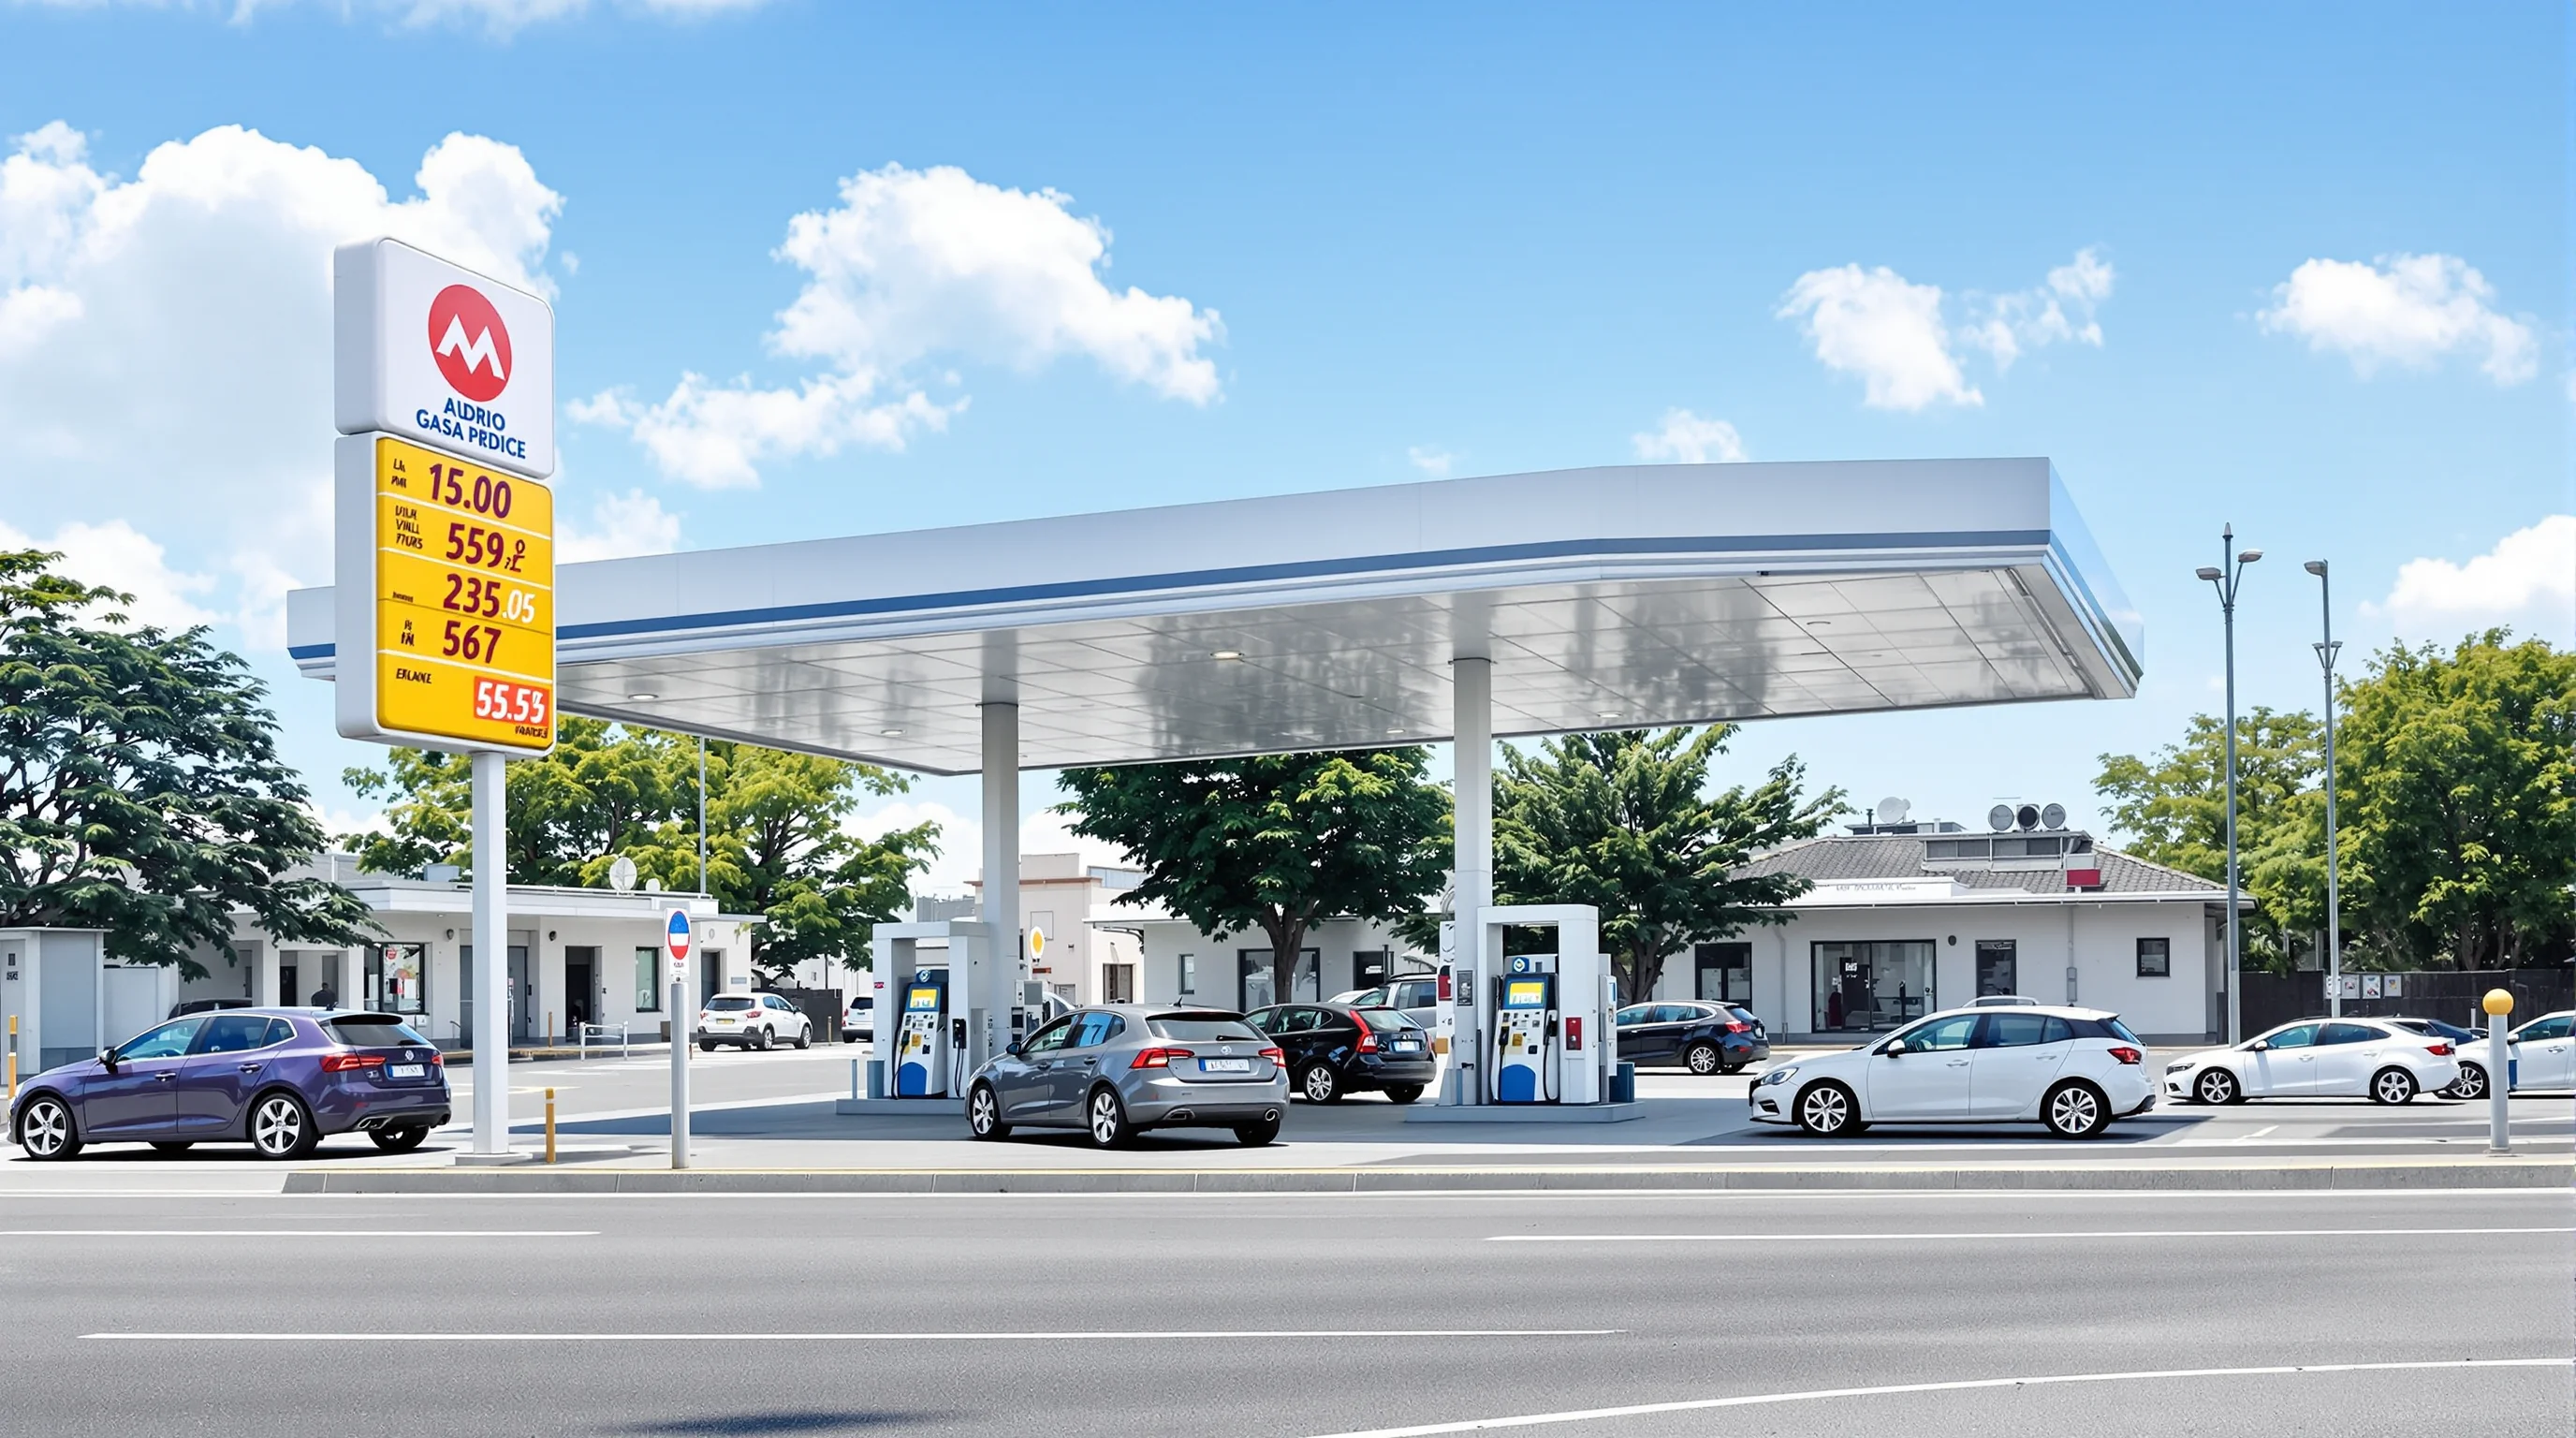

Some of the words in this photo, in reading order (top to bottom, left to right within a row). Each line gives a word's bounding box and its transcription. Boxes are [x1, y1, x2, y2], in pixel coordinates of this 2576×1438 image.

[417, 409, 464, 441] GASA
[429, 463, 512, 519] 15.00
[442, 620, 503, 664] 567
